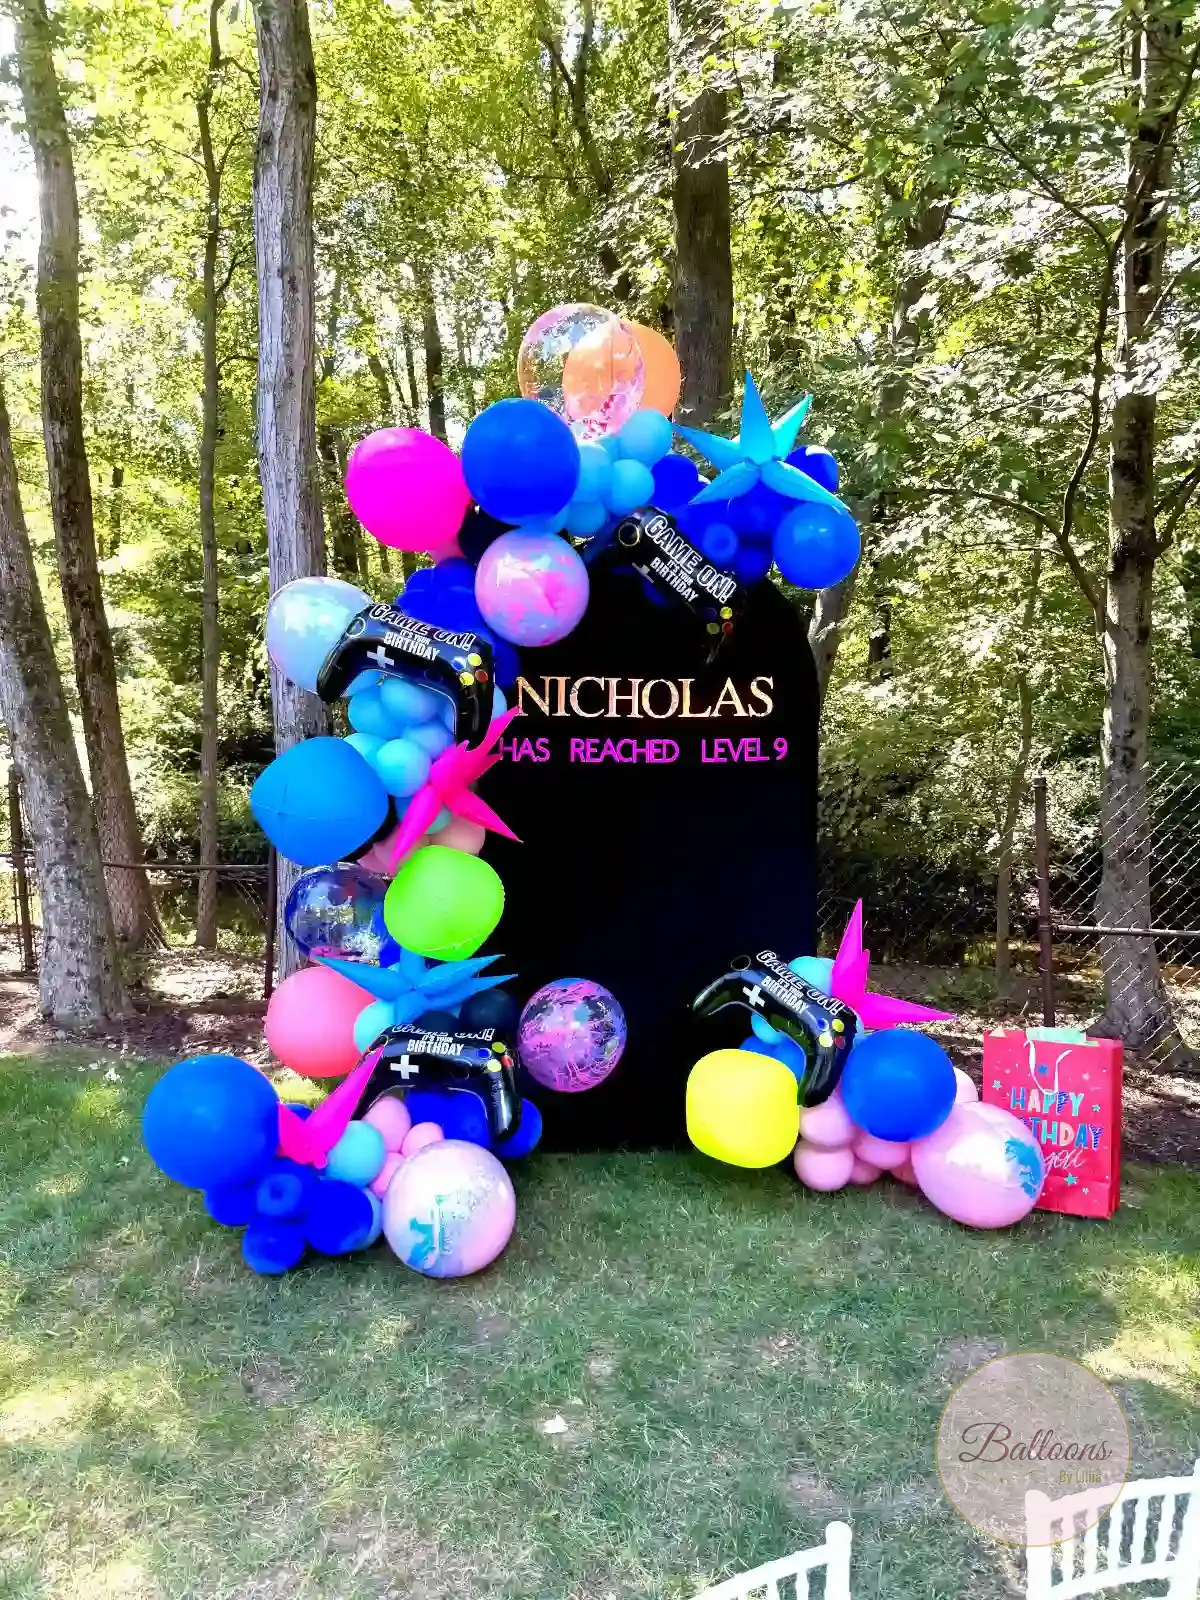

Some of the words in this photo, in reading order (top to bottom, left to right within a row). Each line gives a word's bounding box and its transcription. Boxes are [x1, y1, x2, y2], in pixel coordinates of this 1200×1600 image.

[645, 515, 702, 574] GAME
[697, 565, 737, 604] ON!
[667, 559, 681, 573] IT'S
[678, 569, 694, 585] YOUR
[650, 557, 699, 602] BIRTHDAY
[383, 631, 441, 661] BIRTHDAY
[400, 628, 414, 639] IT'S
[414, 634, 432, 646] YOUR
[515, 676, 774, 719] NICHOLAS
[500, 737, 550, 762] HAS
[570, 738, 680, 763] REACHED
[702, 738, 770, 763] LEVEL
[773, 738, 789, 760] 9
[761, 975, 809, 1014] BIRTHDAY
[406, 1039, 465, 1056] BIRTHDAY
[1011, 1087, 1084, 1116] HAPPY
[1020, 1116, 1104, 1151] THDAY
